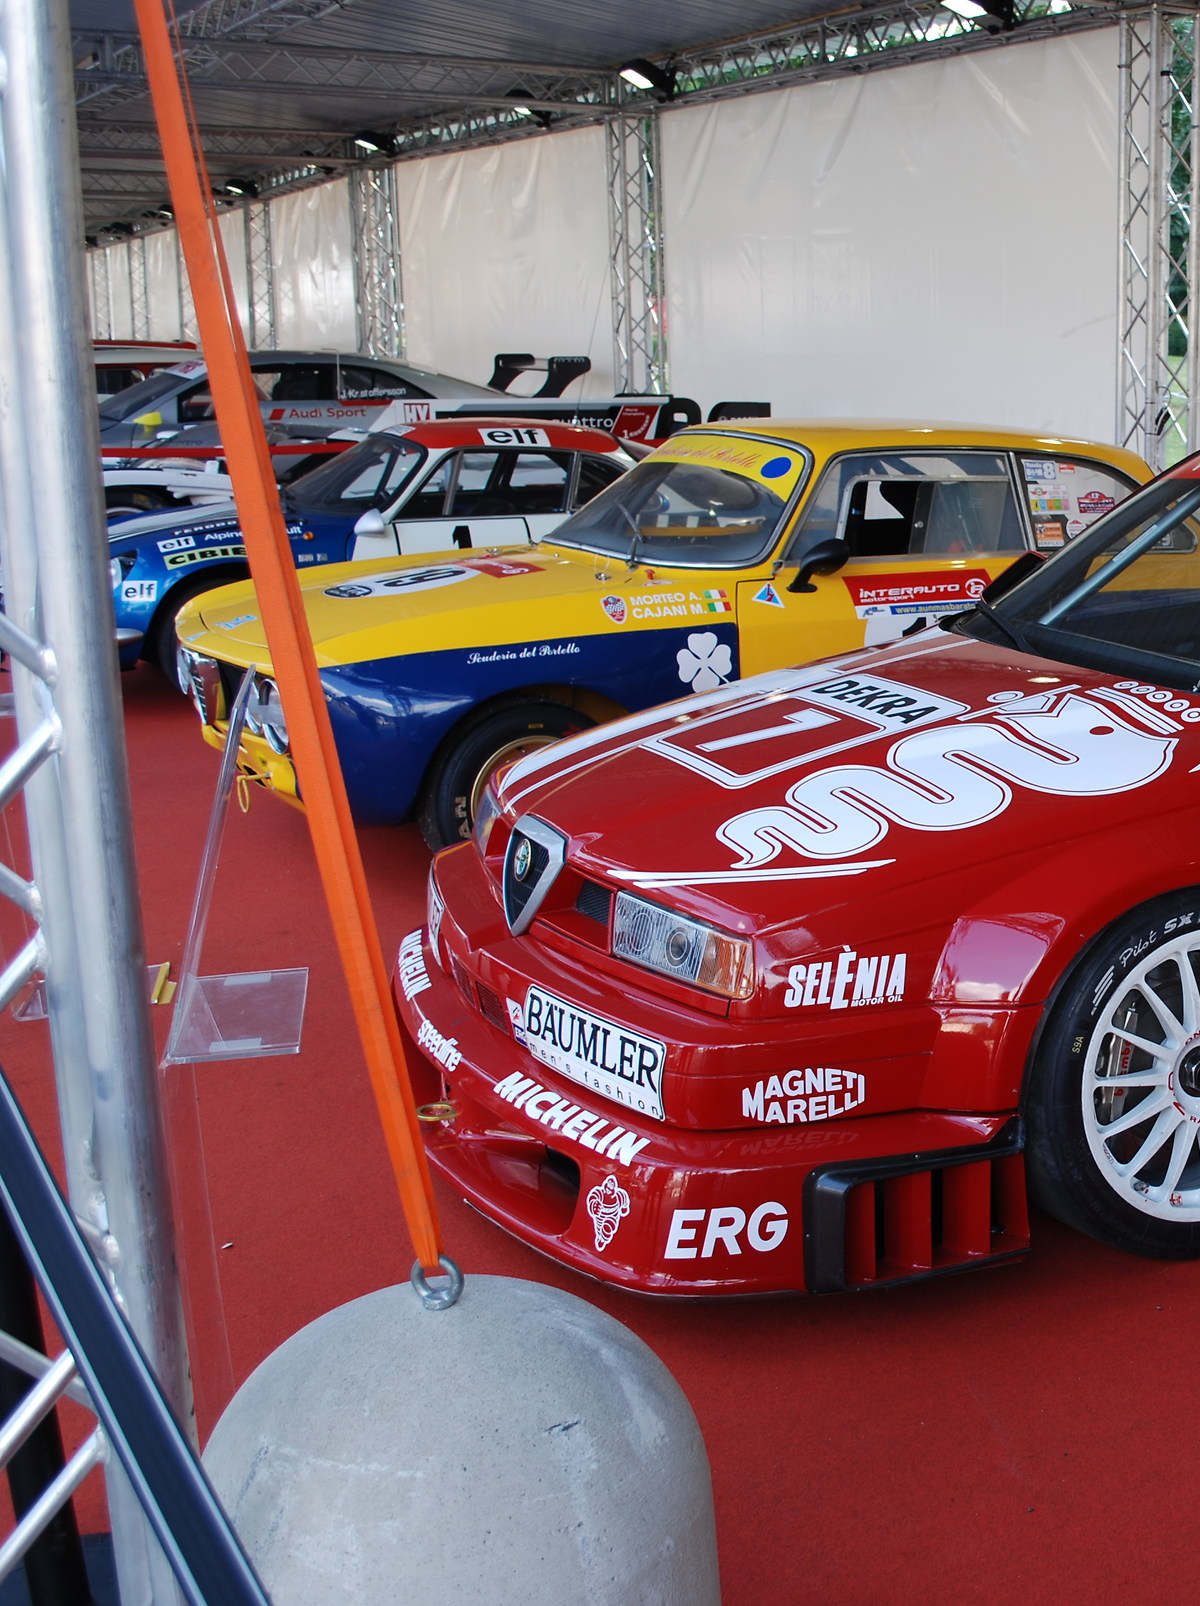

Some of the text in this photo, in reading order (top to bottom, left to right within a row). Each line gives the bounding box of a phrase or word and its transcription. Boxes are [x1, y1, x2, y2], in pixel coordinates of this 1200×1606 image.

[289, 407, 366, 419] Audi Sport
[487, 429, 538, 444] elf
[162, 538, 193, 550] elf
[124, 583, 155, 598] elf
[629, 592, 702, 606] MORTEO A.
[860, 594, 914, 604] motorsport
[632, 604, 688, 619] CAJANI
[691, 603, 708, 614] M.
[467, 643, 580, 664] Scuderia del Portello
[811, 680, 940, 724] DEKRA
[696, 708, 842, 752] 7
[1119, 912, 1194, 967] Pilot SX
[398, 929, 432, 1001] MICHELIN
[851, 995, 903, 1007] MOTOR OIL
[418, 1019, 463, 1072] speedline
[527, 993, 658, 1094] BÄUMLER
[530, 1042, 659, 1116] men's fashion
[742, 1068, 866, 1103] MAGNETI
[493, 1070, 651, 1167] MICHELIN
[742, 1080, 866, 1123] MARELLI
[663, 1201, 789, 1260] ERG
